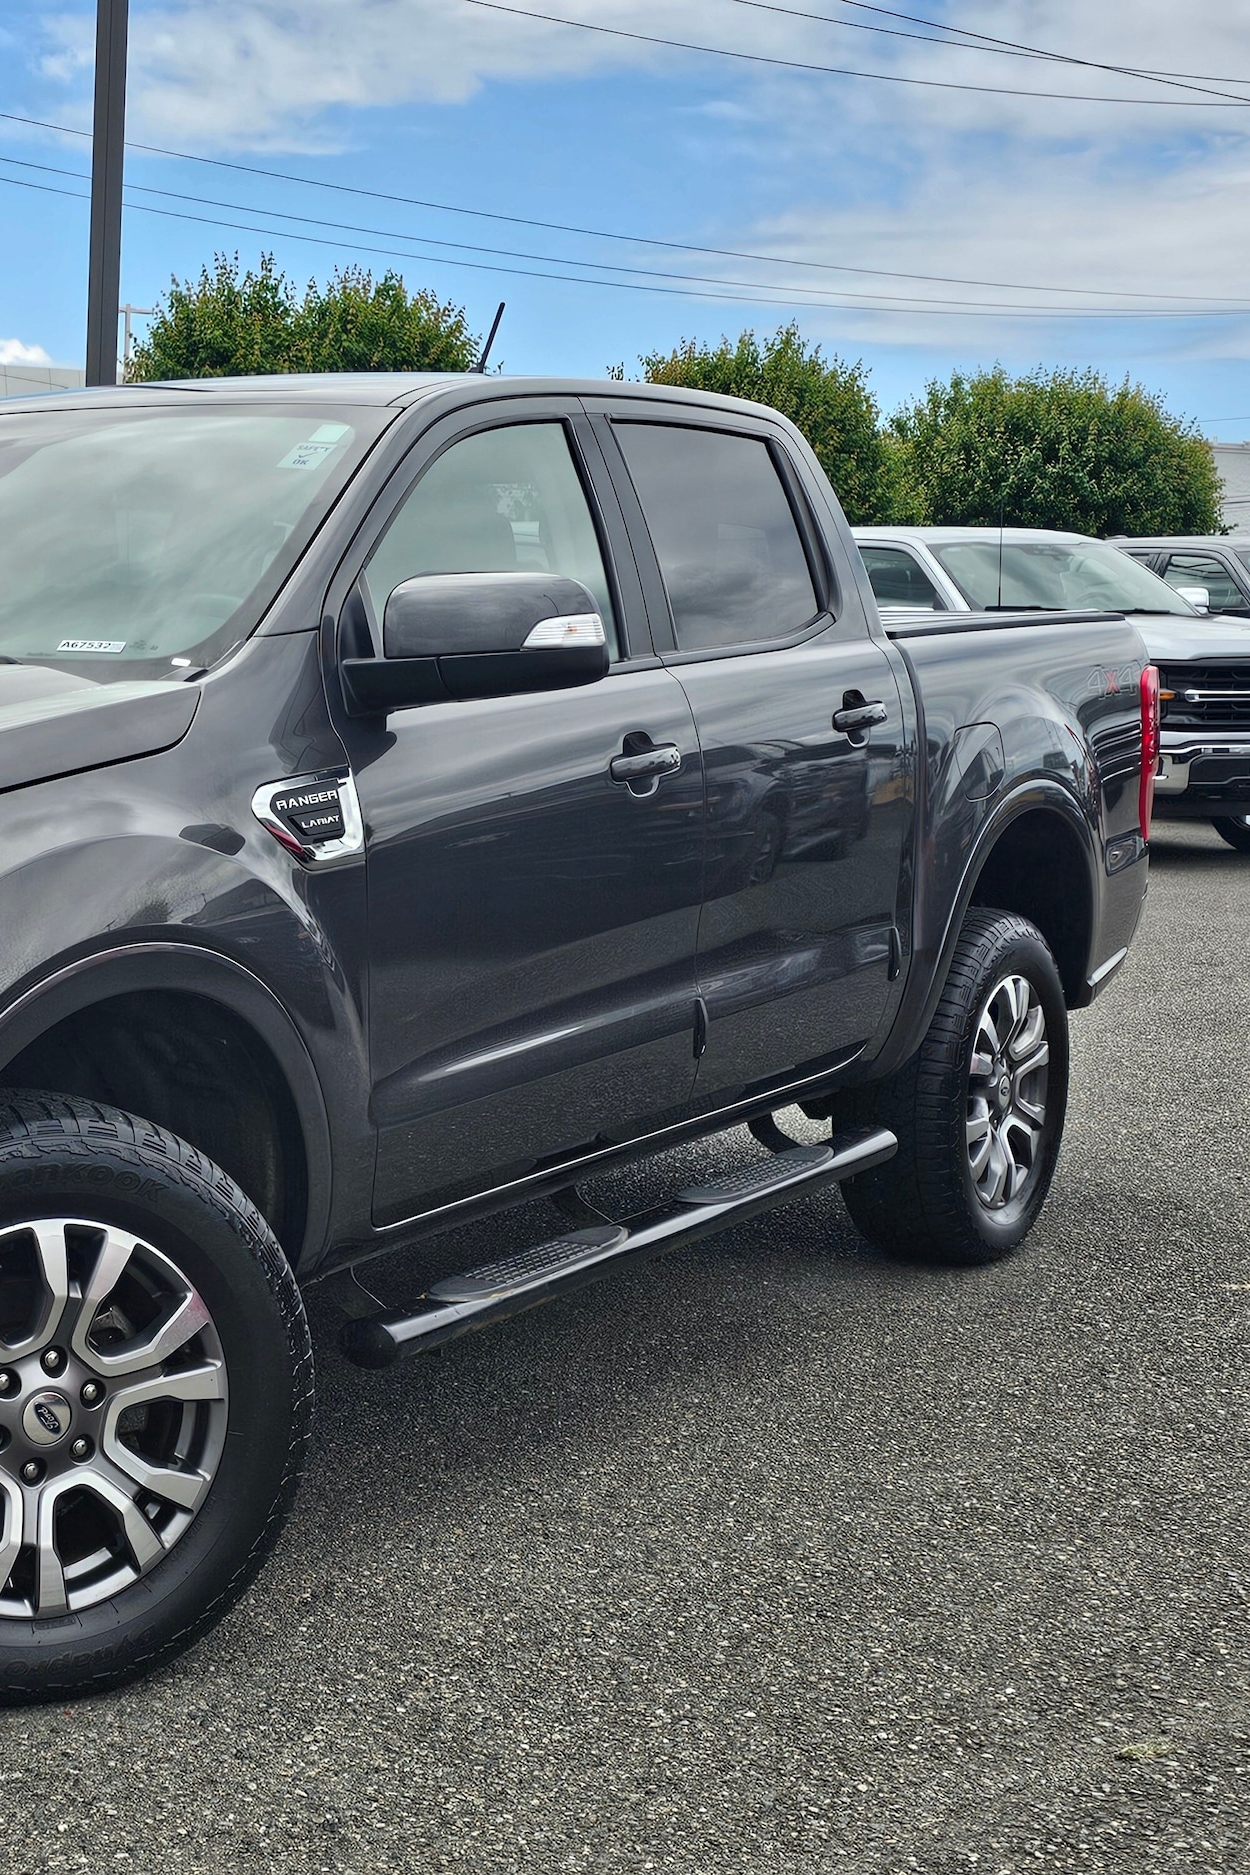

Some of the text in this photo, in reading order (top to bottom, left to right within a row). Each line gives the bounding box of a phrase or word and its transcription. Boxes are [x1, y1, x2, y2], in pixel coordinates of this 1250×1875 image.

[297, 445, 330, 453] SAFETY
[275, 790, 338, 811] RANGER
[301, 815, 340, 829] LARIAT
